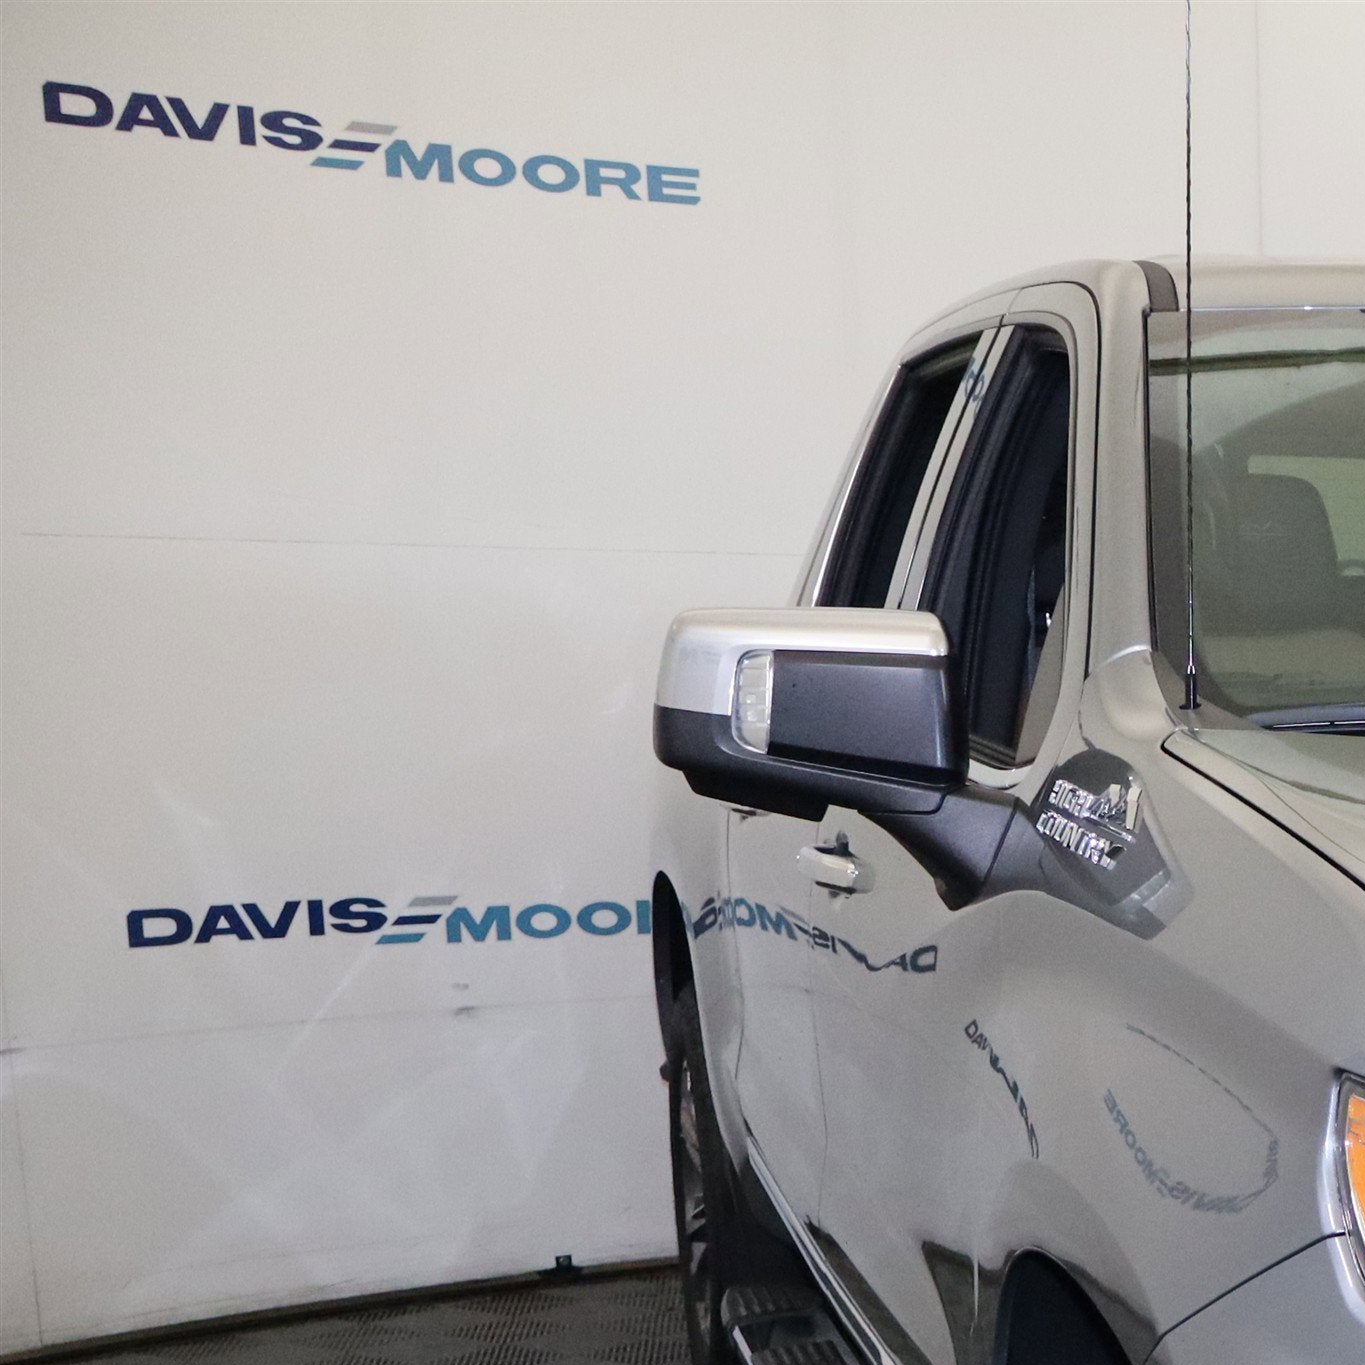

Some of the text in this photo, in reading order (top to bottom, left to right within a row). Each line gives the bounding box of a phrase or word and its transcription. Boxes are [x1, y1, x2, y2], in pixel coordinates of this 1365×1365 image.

[42, 80, 701, 206] DAVIS MOORE
[126, 897, 388, 949] DAVIS
[446, 899, 652, 943] MOO
